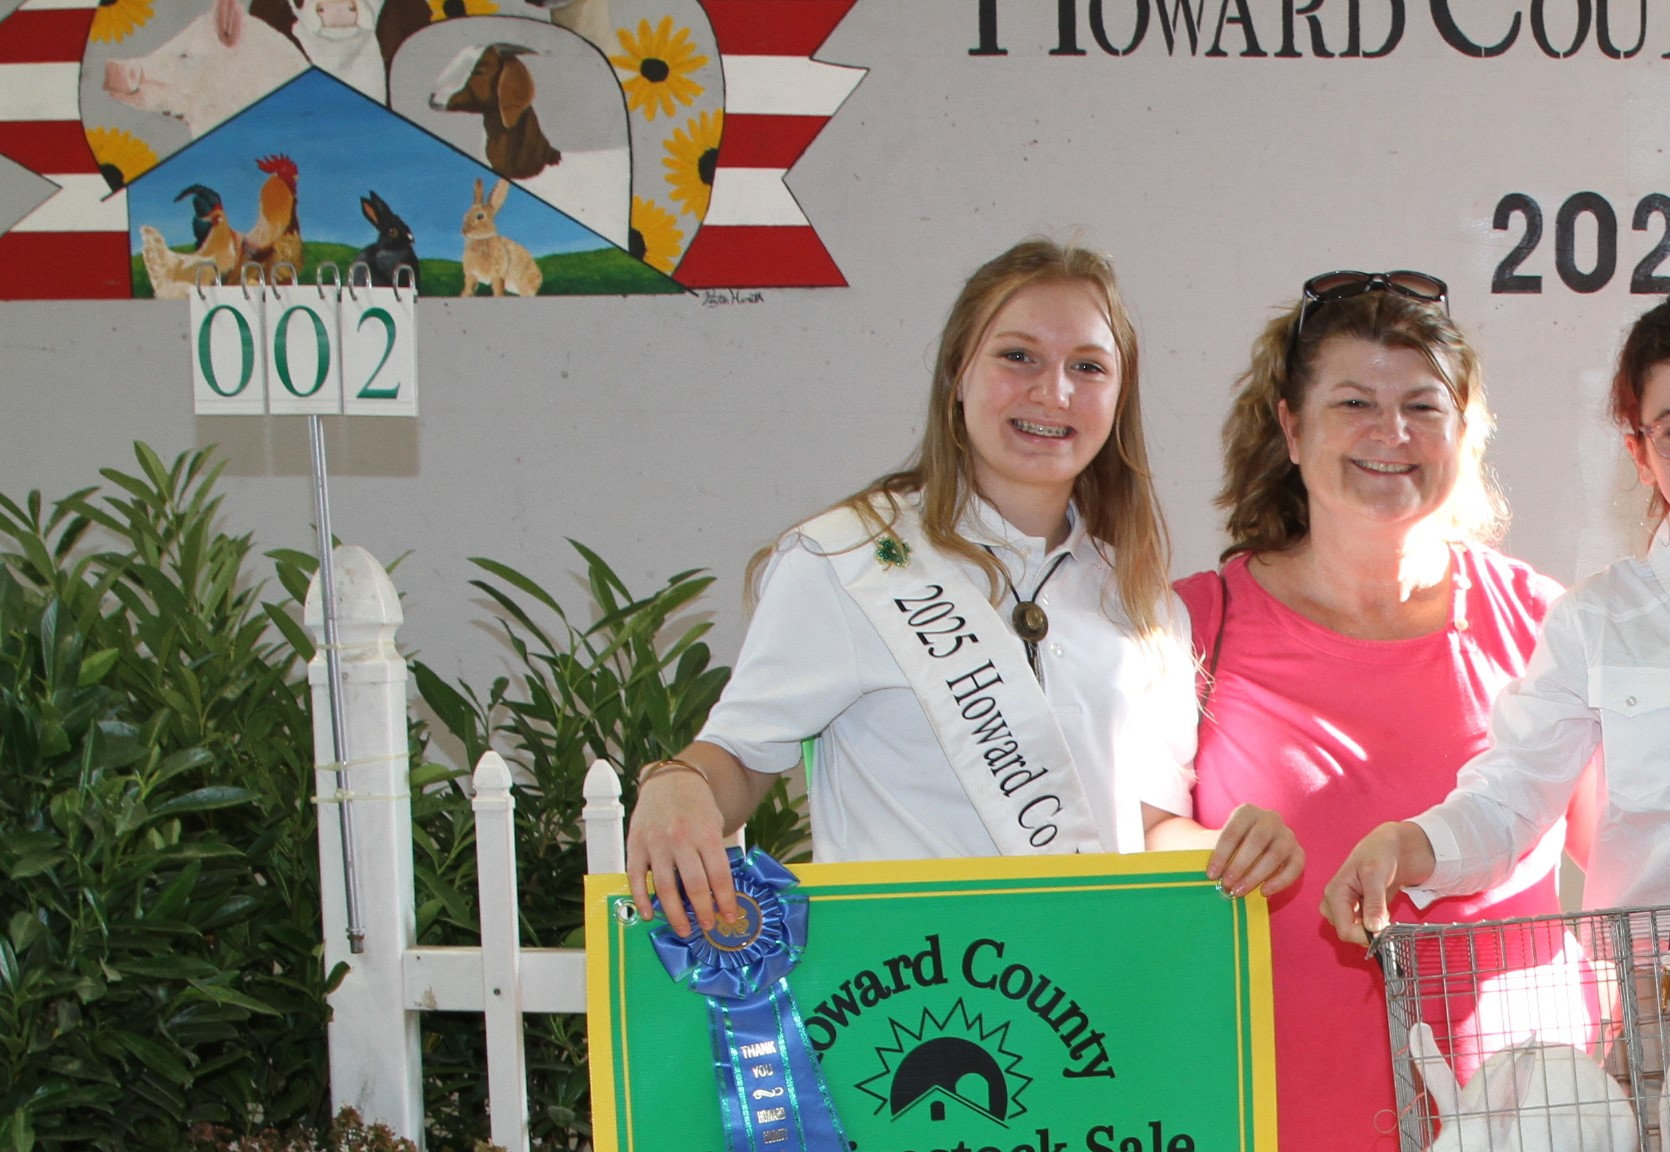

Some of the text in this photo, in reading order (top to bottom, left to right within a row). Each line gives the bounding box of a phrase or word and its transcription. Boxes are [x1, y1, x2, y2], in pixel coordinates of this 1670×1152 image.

[894, 584, 1063, 848] 2025 Howard Co
[804, 934, 1115, 1078] oward County
[740, 1040, 777, 1060] THANK
[752, 1063, 774, 1079] YOU
